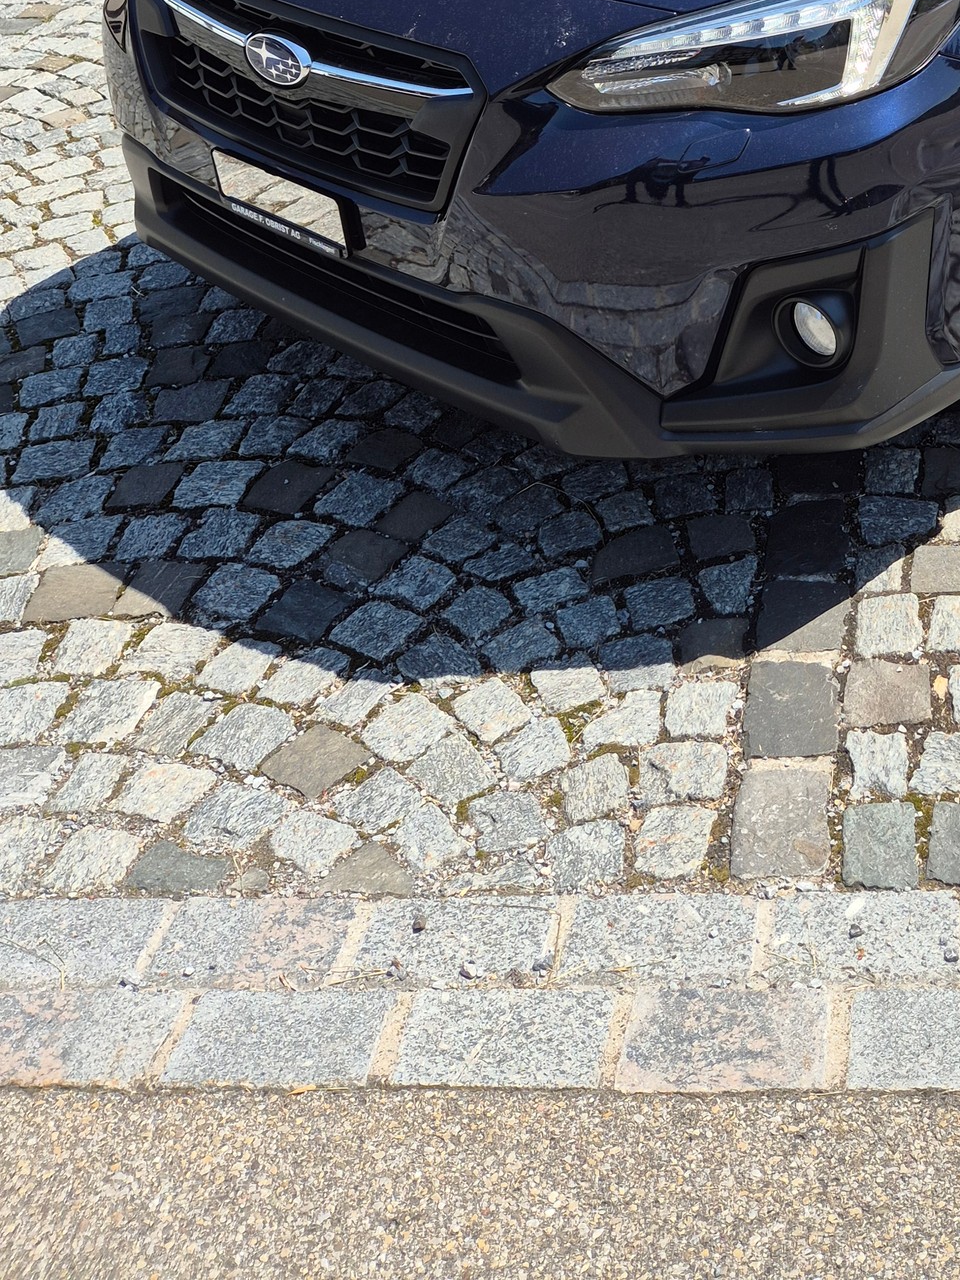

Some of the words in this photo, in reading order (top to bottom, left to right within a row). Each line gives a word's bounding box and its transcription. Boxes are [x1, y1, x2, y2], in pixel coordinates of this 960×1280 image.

[231, 203, 258, 221] GARAGE
[265, 218, 290, 235] OBRIST
[290, 228, 301, 240] AG
